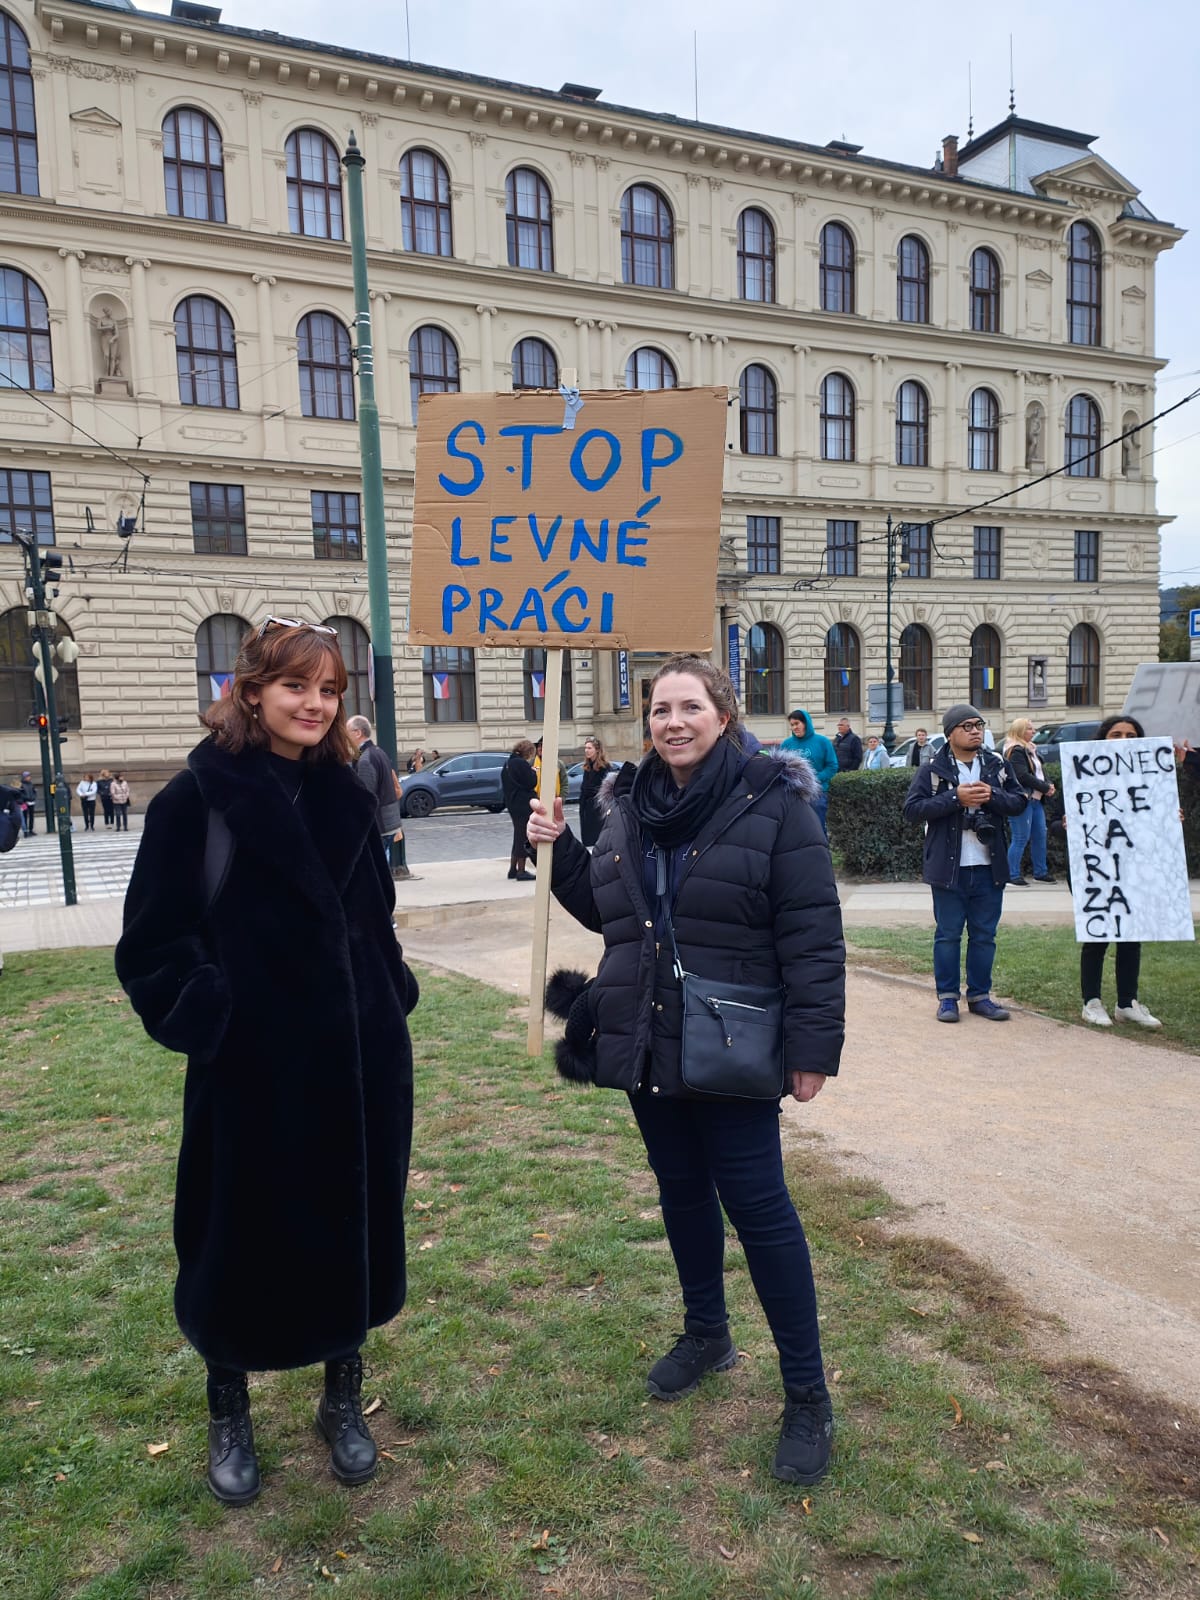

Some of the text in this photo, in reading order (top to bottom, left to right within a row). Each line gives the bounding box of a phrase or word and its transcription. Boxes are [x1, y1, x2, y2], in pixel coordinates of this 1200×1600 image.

[438, 420, 684, 496] STOP
[450, 496, 662, 567] LEVNÉ
[441, 569, 614, 635] PRÁCI
[1073, 746, 1174, 779] KONEC
[1076, 784, 1151, 815] PRE
[1083, 819, 1134, 849] KA
[1083, 853, 1120, 882] RI
[1083, 885, 1131, 914] ZA
[1086, 914, 1121, 938] CI
